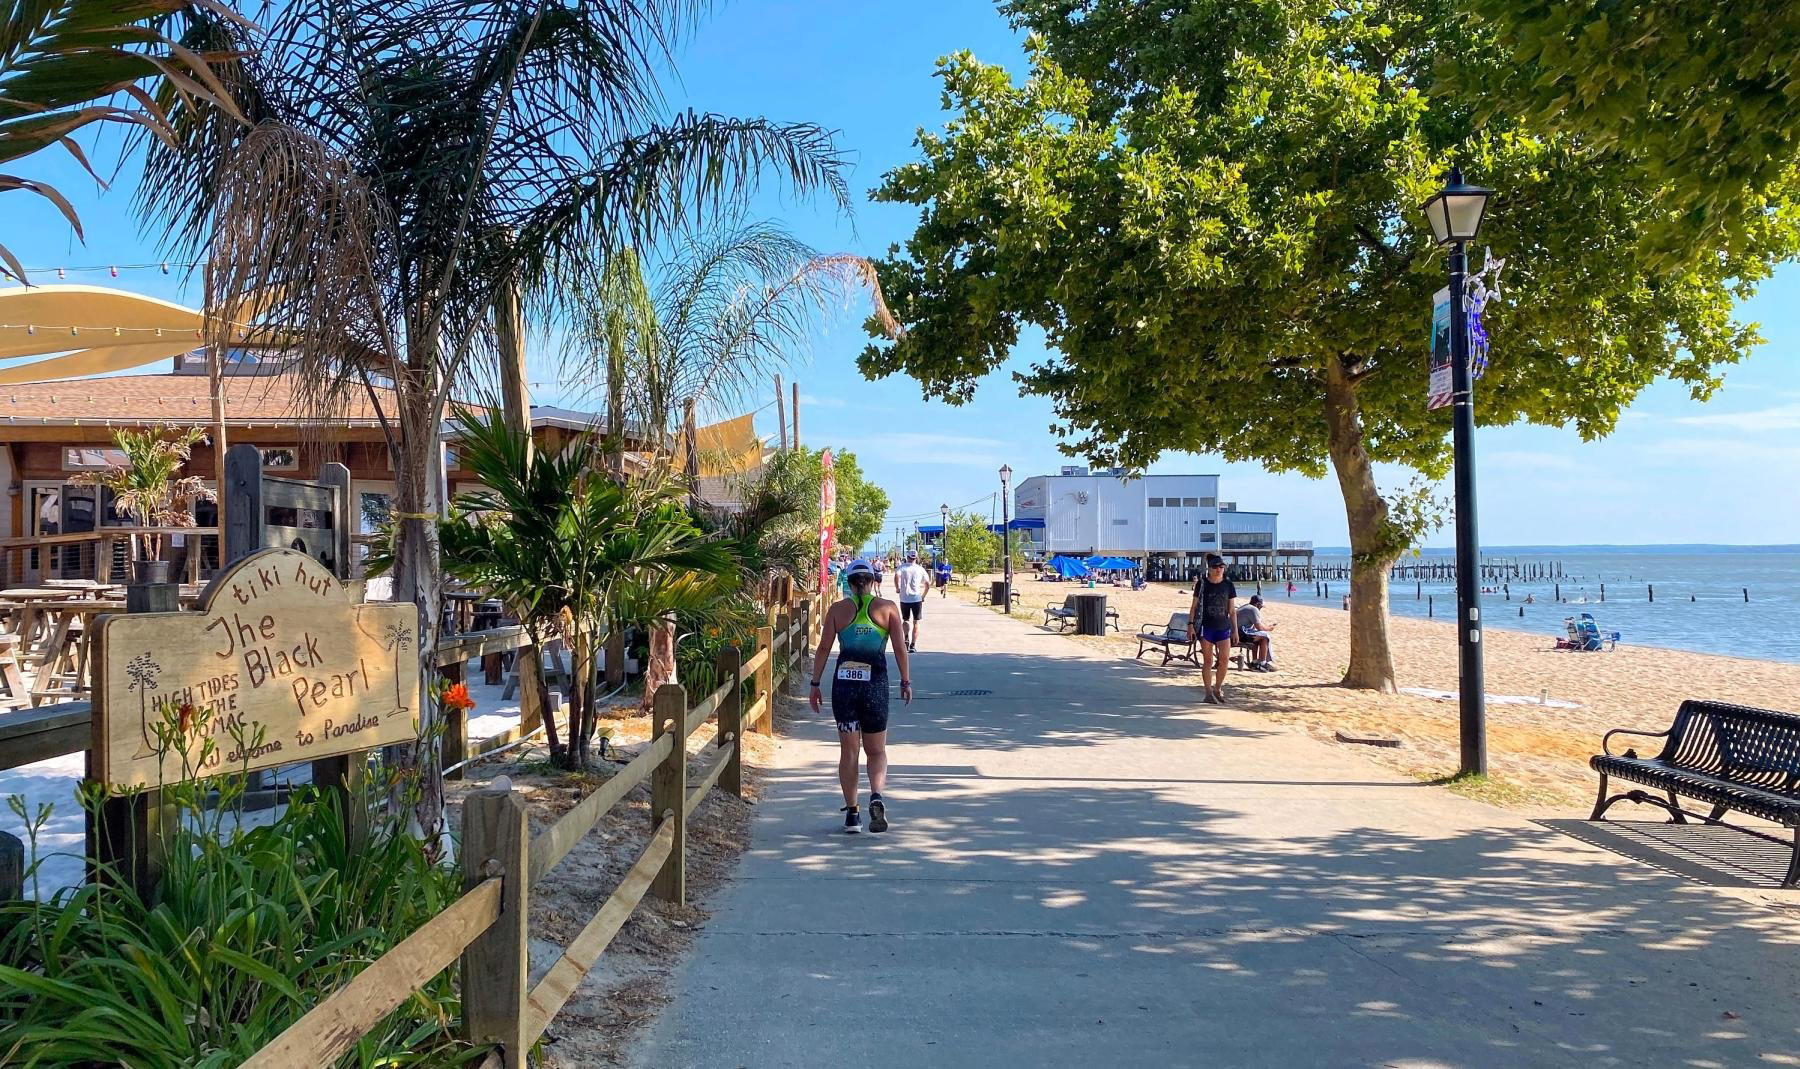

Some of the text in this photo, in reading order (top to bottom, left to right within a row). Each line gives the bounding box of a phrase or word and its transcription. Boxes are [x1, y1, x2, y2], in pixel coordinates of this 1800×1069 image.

[231, 561, 332, 605] tiki hut
[205, 612, 276, 660] The
[244, 632, 323, 689] Black
[845, 669, 863, 680] 386
[151, 673, 240, 713] HIGH TIDES
[206, 694, 237, 716] THE
[291, 658, 370, 717] Pearl
[295, 729, 315, 748] to
[323, 713, 380, 741] Paradise
